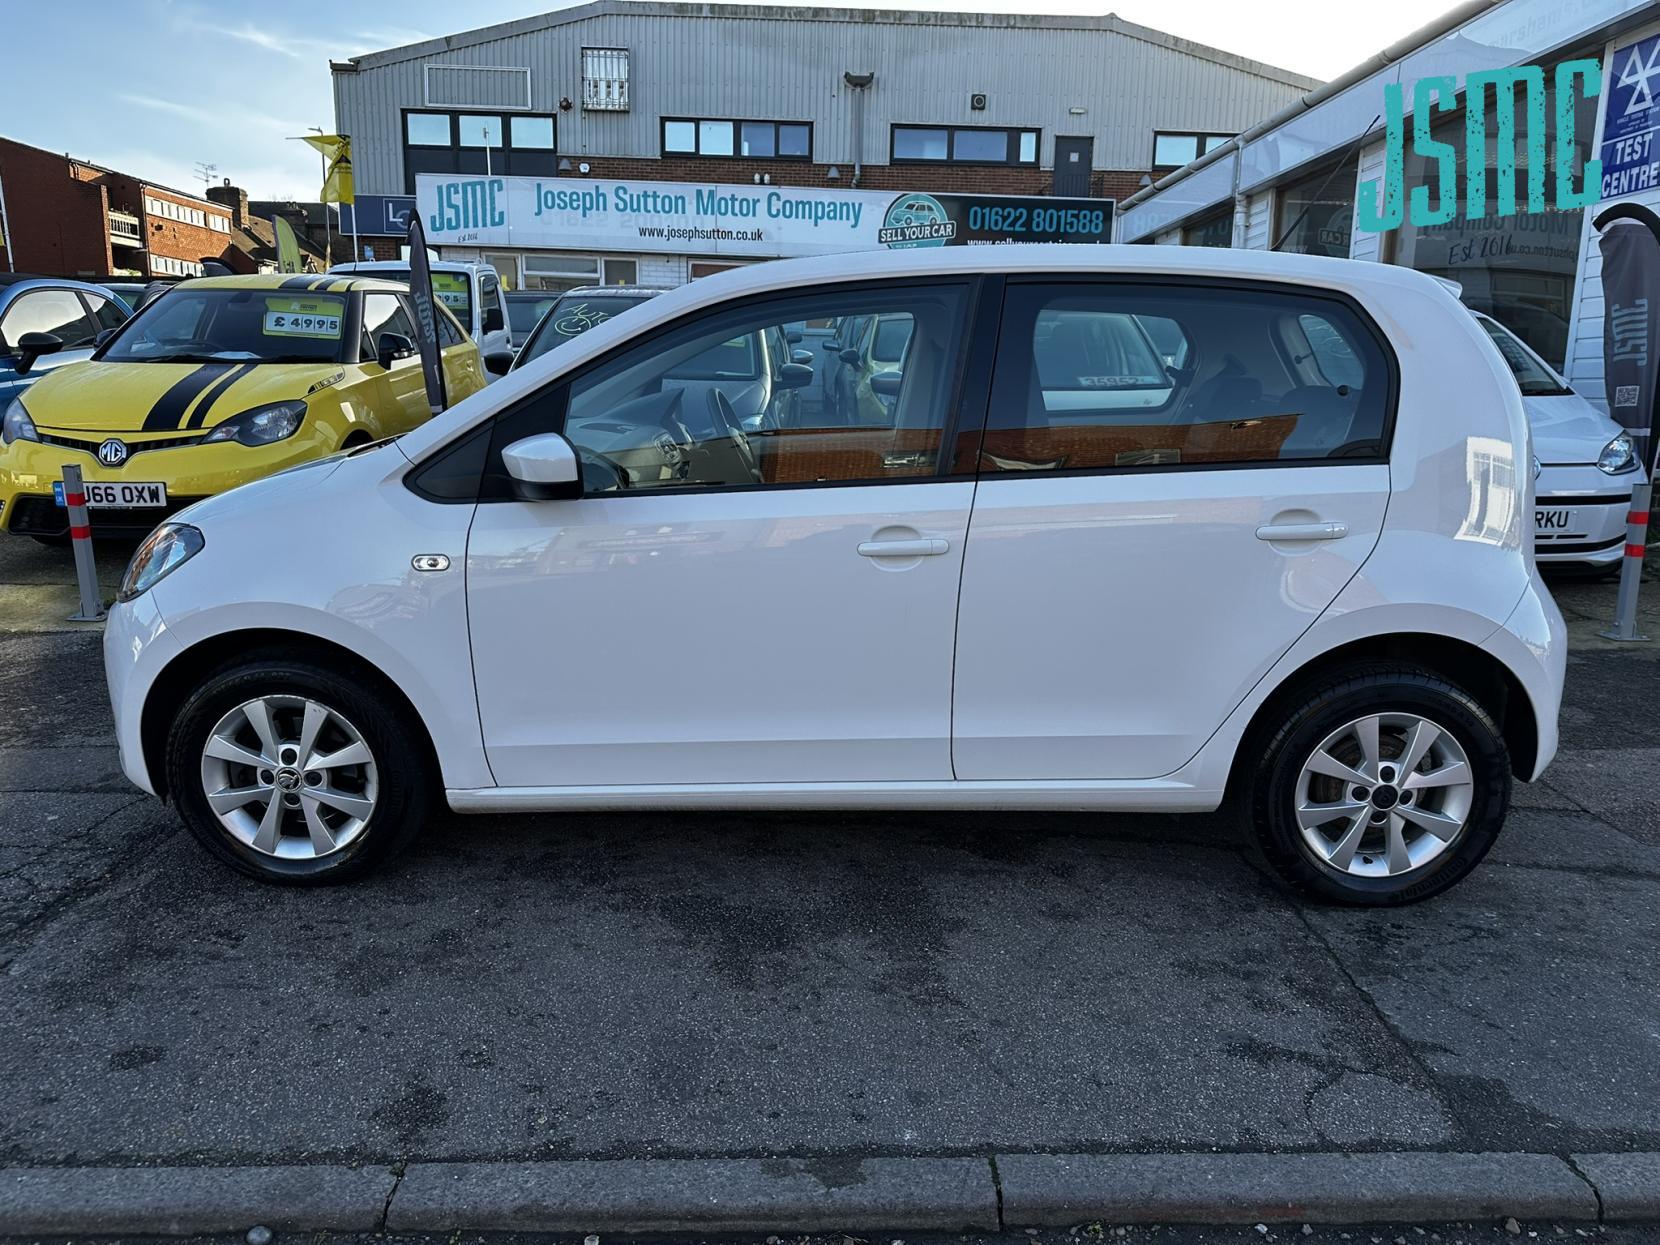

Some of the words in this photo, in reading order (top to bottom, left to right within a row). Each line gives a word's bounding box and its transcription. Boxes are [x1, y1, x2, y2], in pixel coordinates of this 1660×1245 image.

[1615, 132, 1654, 165] TEST
[1601, 160, 1660, 198] CENTRE
[430, 178, 505, 233] JSMC
[534, 182, 608, 217] Joseph
[614, 185, 687, 215] Sutton
[695, 188, 760, 218] Motor
[766, 190, 863, 229] Company
[969, 206, 1027, 232] 01622
[1032, 208, 1104, 234] 801588
[638, 225, 764, 243] www.josephsutton.co.uk
[880, 227, 904, 242] SELL
[904, 225, 932, 240] YOUR
[932, 223, 953, 238] CAR
[101, 442, 122, 462] MG
[122, 486, 160, 504] OXW
[1535, 511, 1569, 529] RKU
